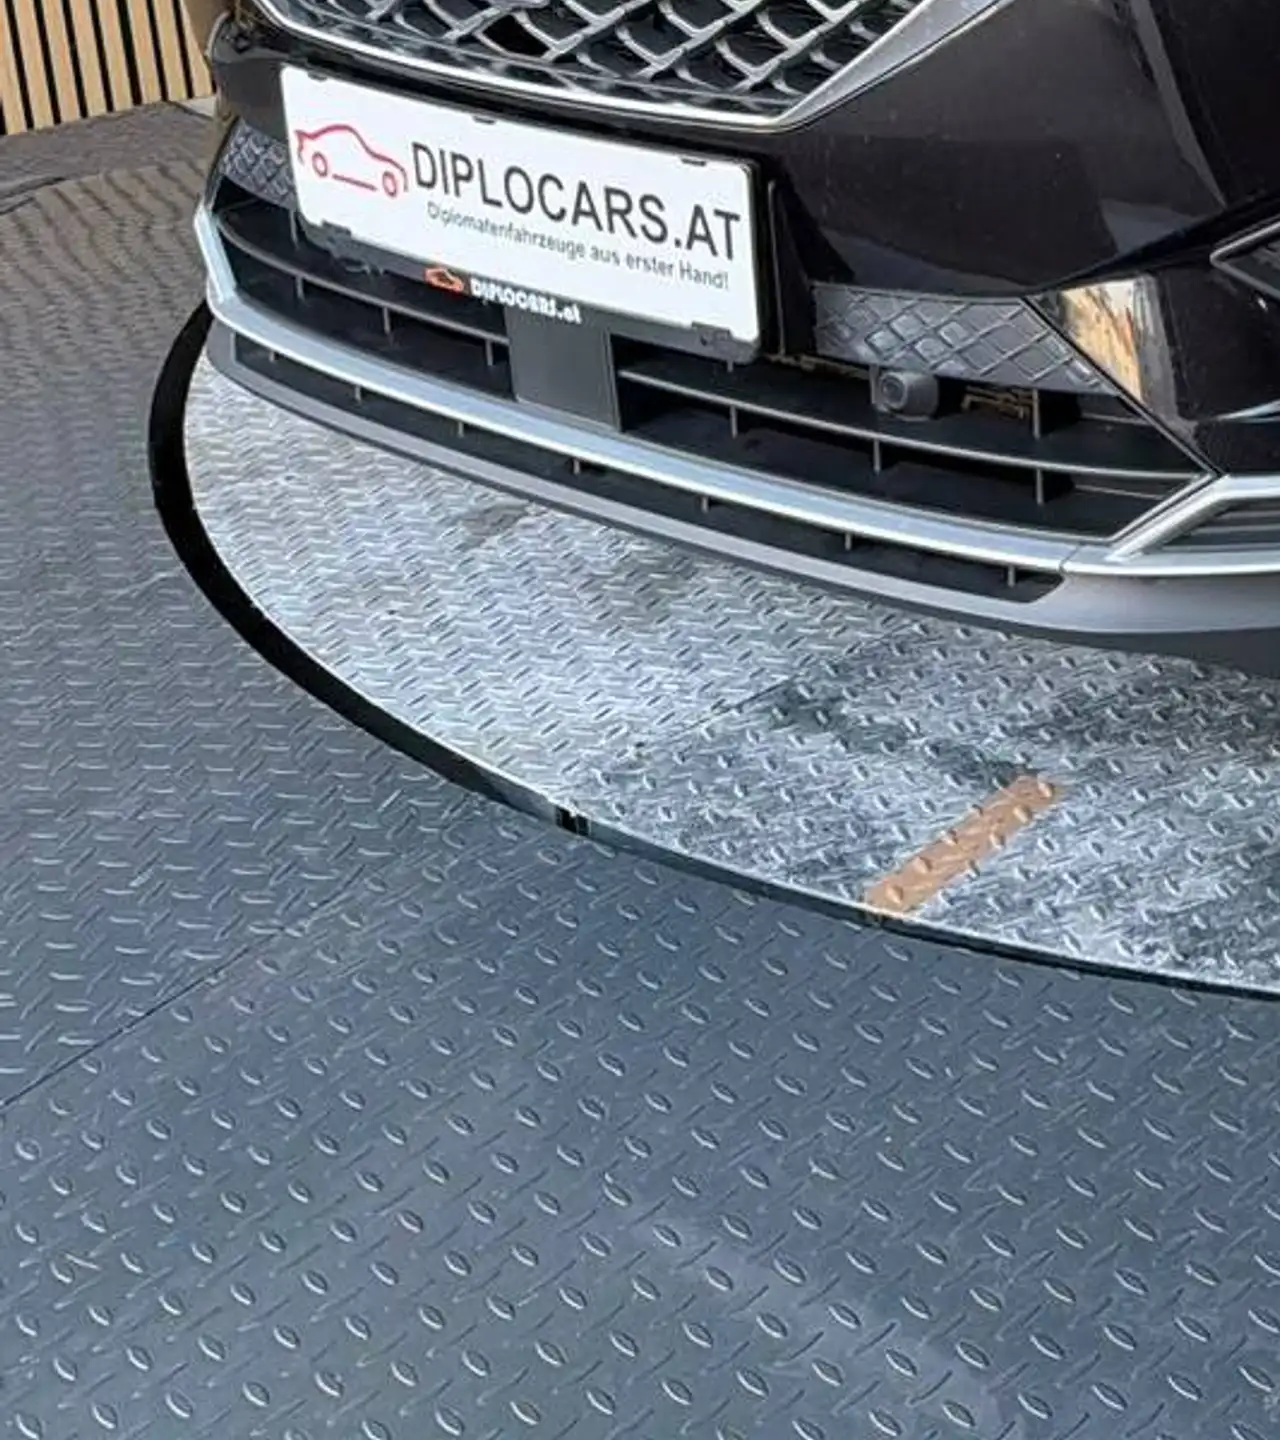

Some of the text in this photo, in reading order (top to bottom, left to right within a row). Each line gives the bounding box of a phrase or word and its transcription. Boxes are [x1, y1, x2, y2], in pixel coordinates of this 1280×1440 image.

[411, 141, 741, 261] DIPLOCARS.AT
[427, 200, 730, 291] Diplomatenfahrzeuge aus erster Hand!
